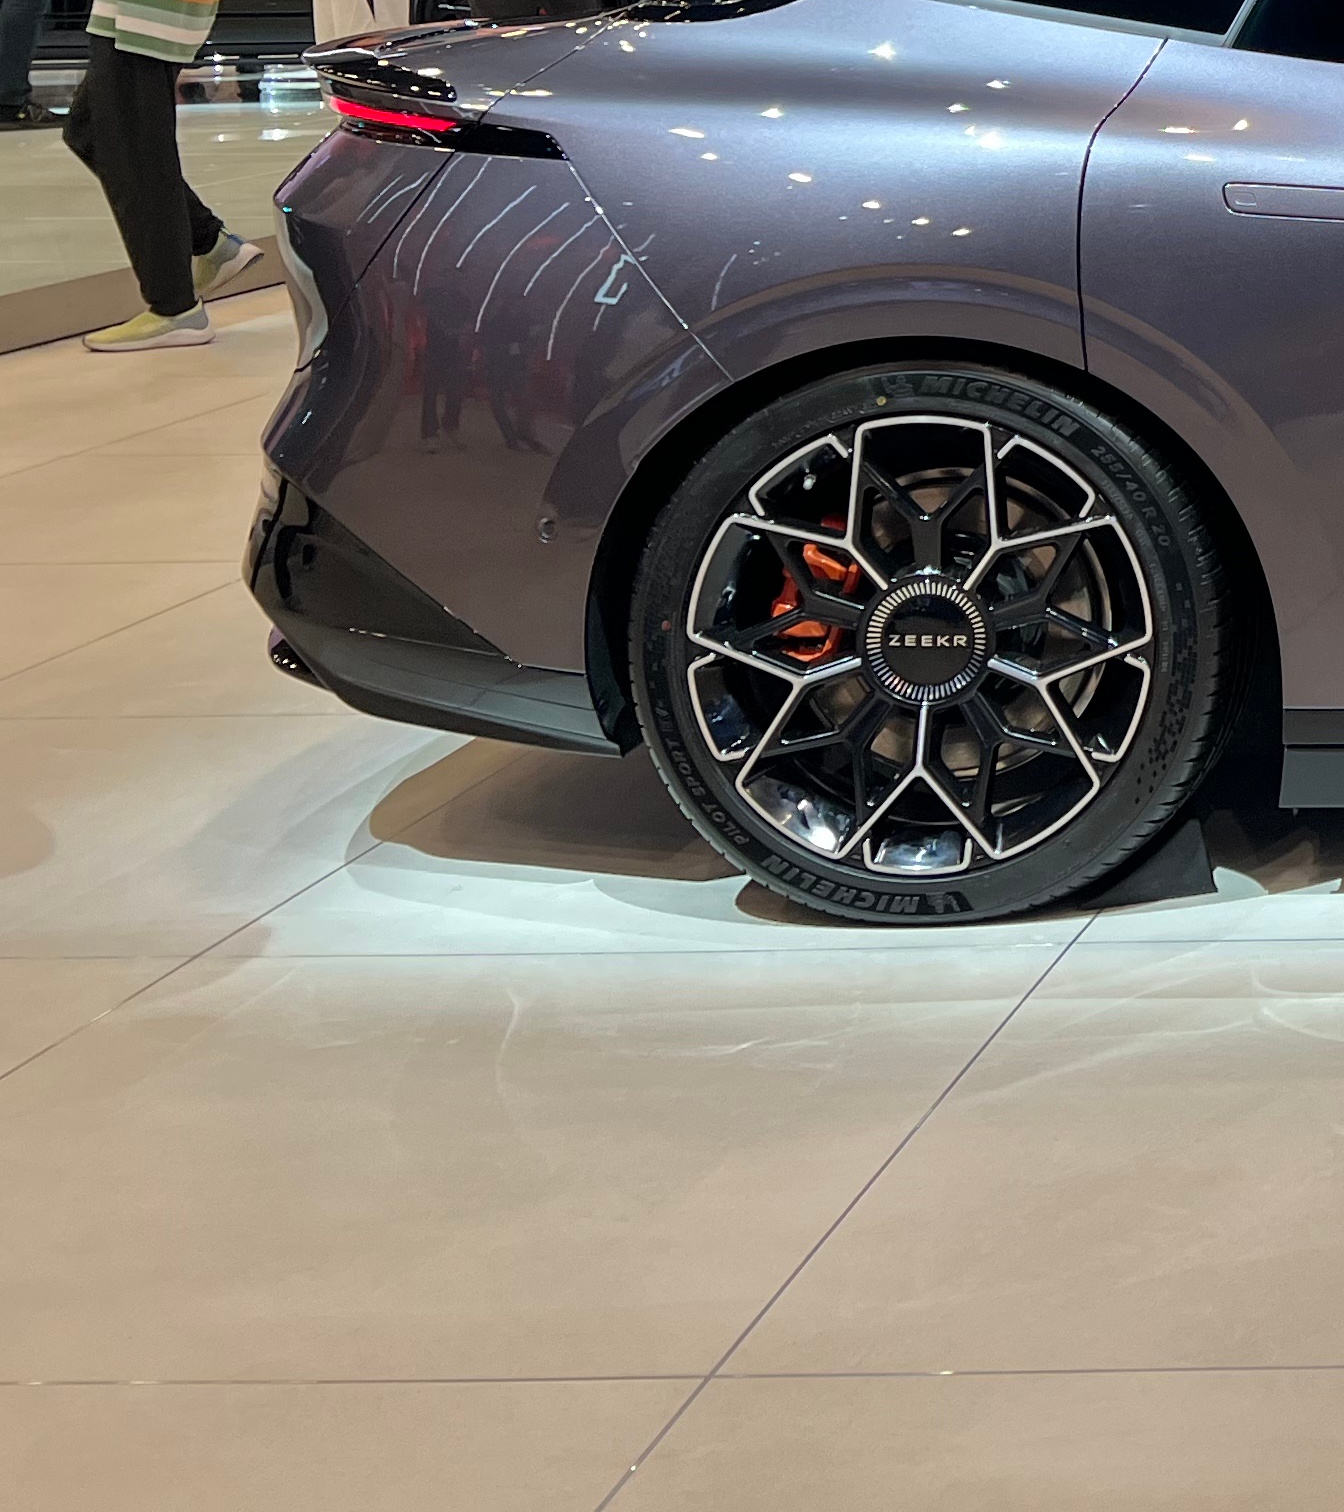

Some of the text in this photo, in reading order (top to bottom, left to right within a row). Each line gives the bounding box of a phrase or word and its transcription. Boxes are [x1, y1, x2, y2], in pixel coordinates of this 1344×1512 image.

[918, 375, 1080, 437] MICHELIN
[888, 634, 968, 647] ZEEKR
[665, 738, 750, 845] PILOT SPORT
[759, 854, 921, 914] MICHELIN
